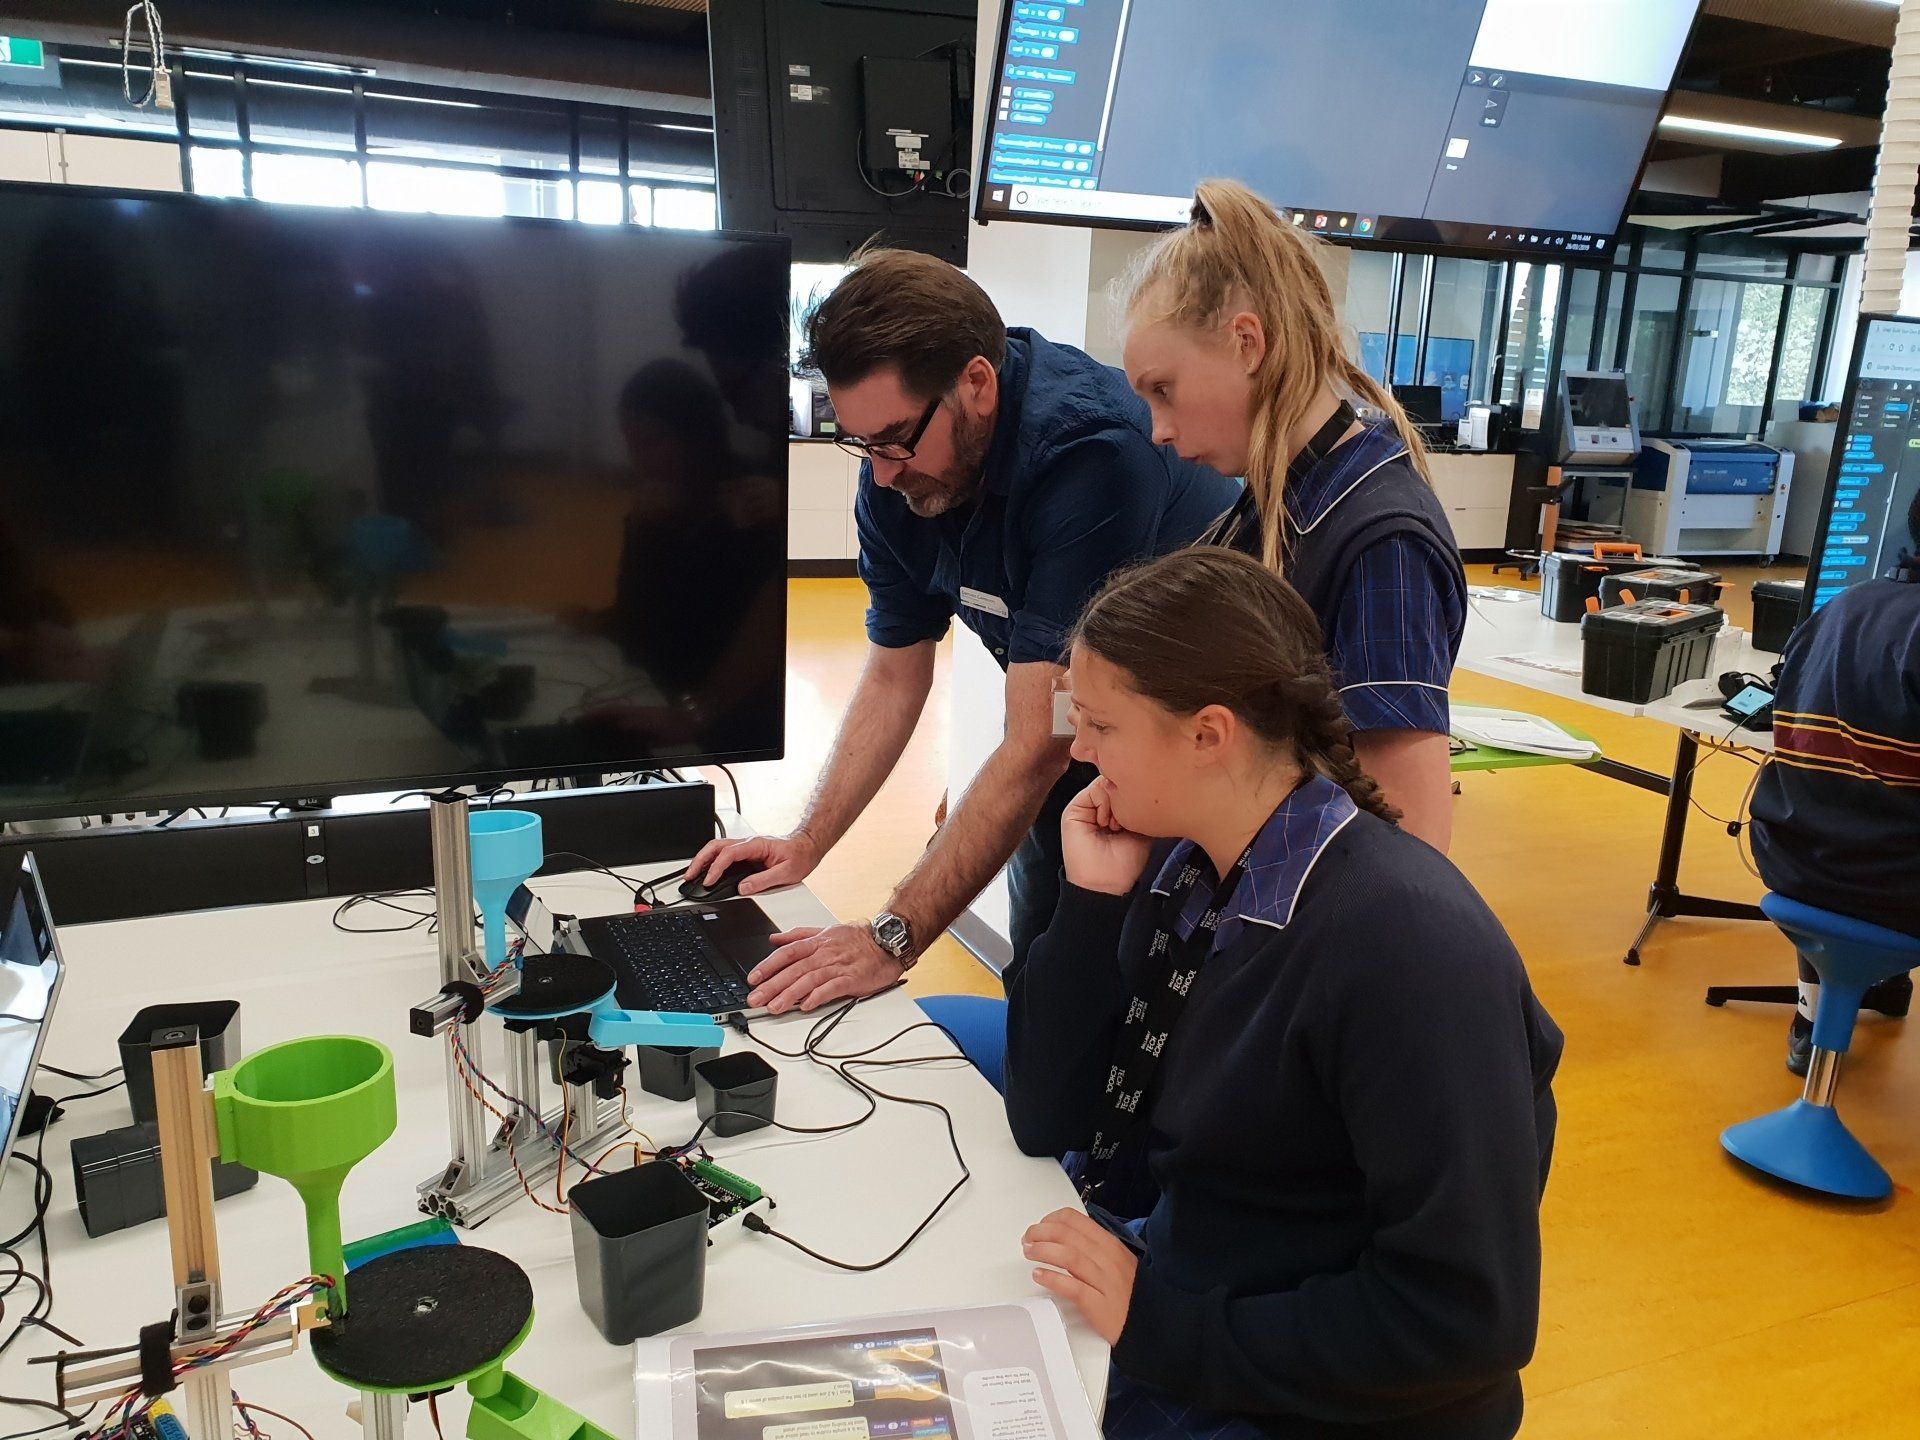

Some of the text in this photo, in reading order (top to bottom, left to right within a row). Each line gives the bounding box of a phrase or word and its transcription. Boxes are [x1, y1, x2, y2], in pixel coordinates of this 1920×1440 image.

[1174, 864, 1190, 890] SCHOOL
[1184, 868, 1196, 884] TECH
[1204, 912, 1217, 928] TECH
[1148, 929, 1161, 957] SCHOOL
[1157, 933, 1165, 950] TECH
[1172, 974, 1184, 992] TECH
[1179, 970, 1197, 996] SCHOOL
[1125, 996, 1139, 1024] SCHOOL
[1135, 1000, 1145, 1018] TECH
[1145, 1036, 1158, 1053] TECH
[1153, 1032, 1168, 1058] SCHOOL
[1106, 1065, 1118, 1094] SCHOOL
[1116, 1069, 1126, 1086] TECH
[1120, 1094, 1131, 1110] TECH
[1128, 1089, 1142, 1113] SCHOOL
